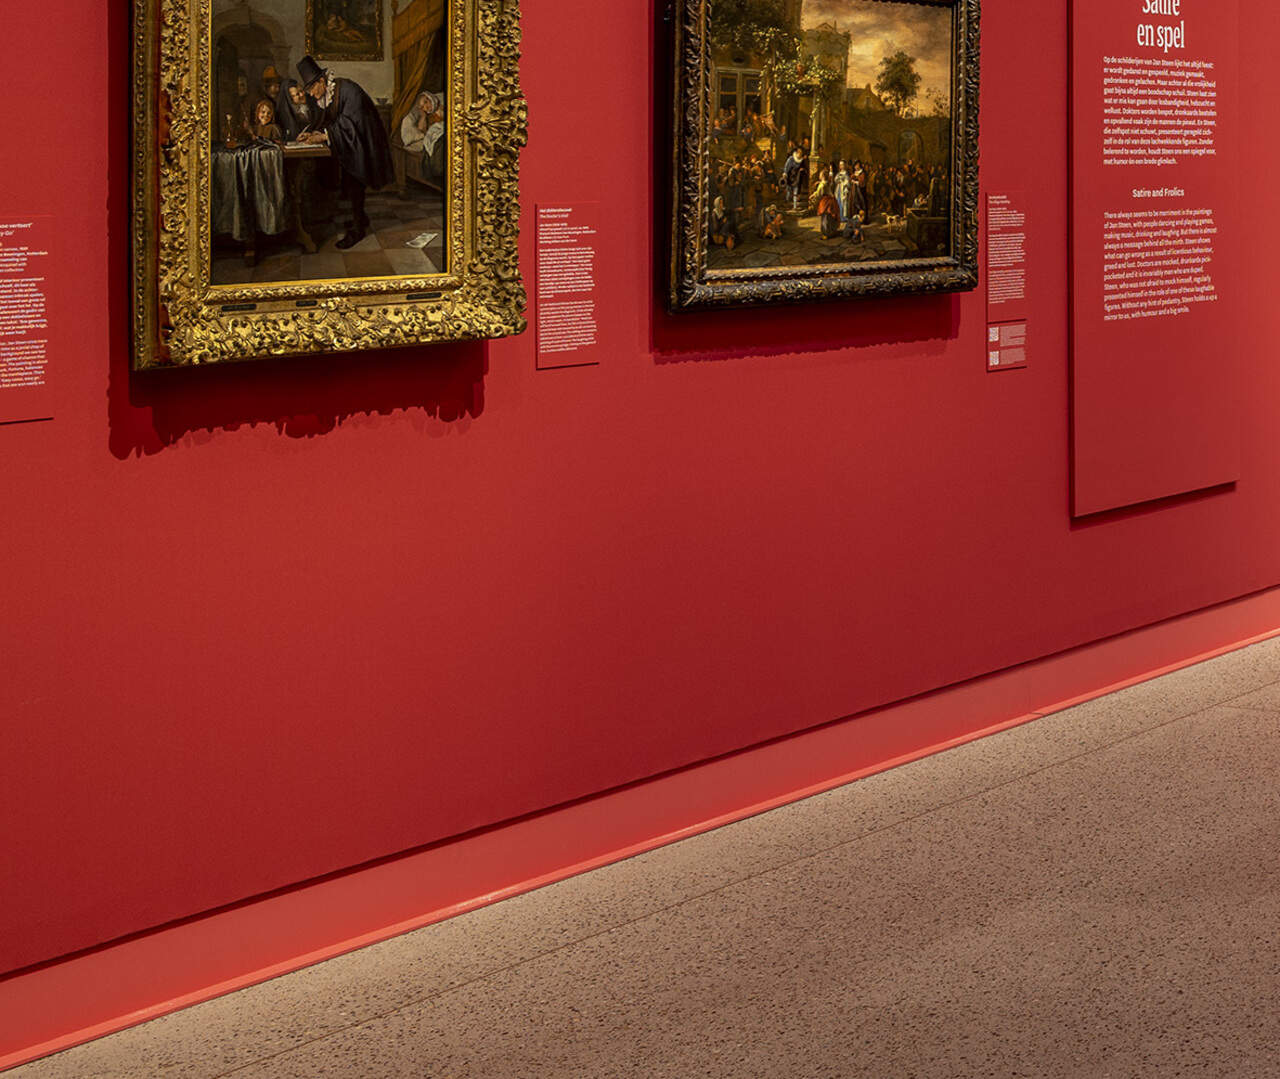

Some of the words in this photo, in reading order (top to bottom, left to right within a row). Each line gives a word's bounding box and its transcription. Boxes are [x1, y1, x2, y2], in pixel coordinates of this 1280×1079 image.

[1137, 23, 1154, 46] en
[1156, 20, 1184, 53] spel
[1132, 187, 1151, 198] Satire
[1152, 187, 1163, 197] and
[1164, 186, 1184, 196] Frolics
